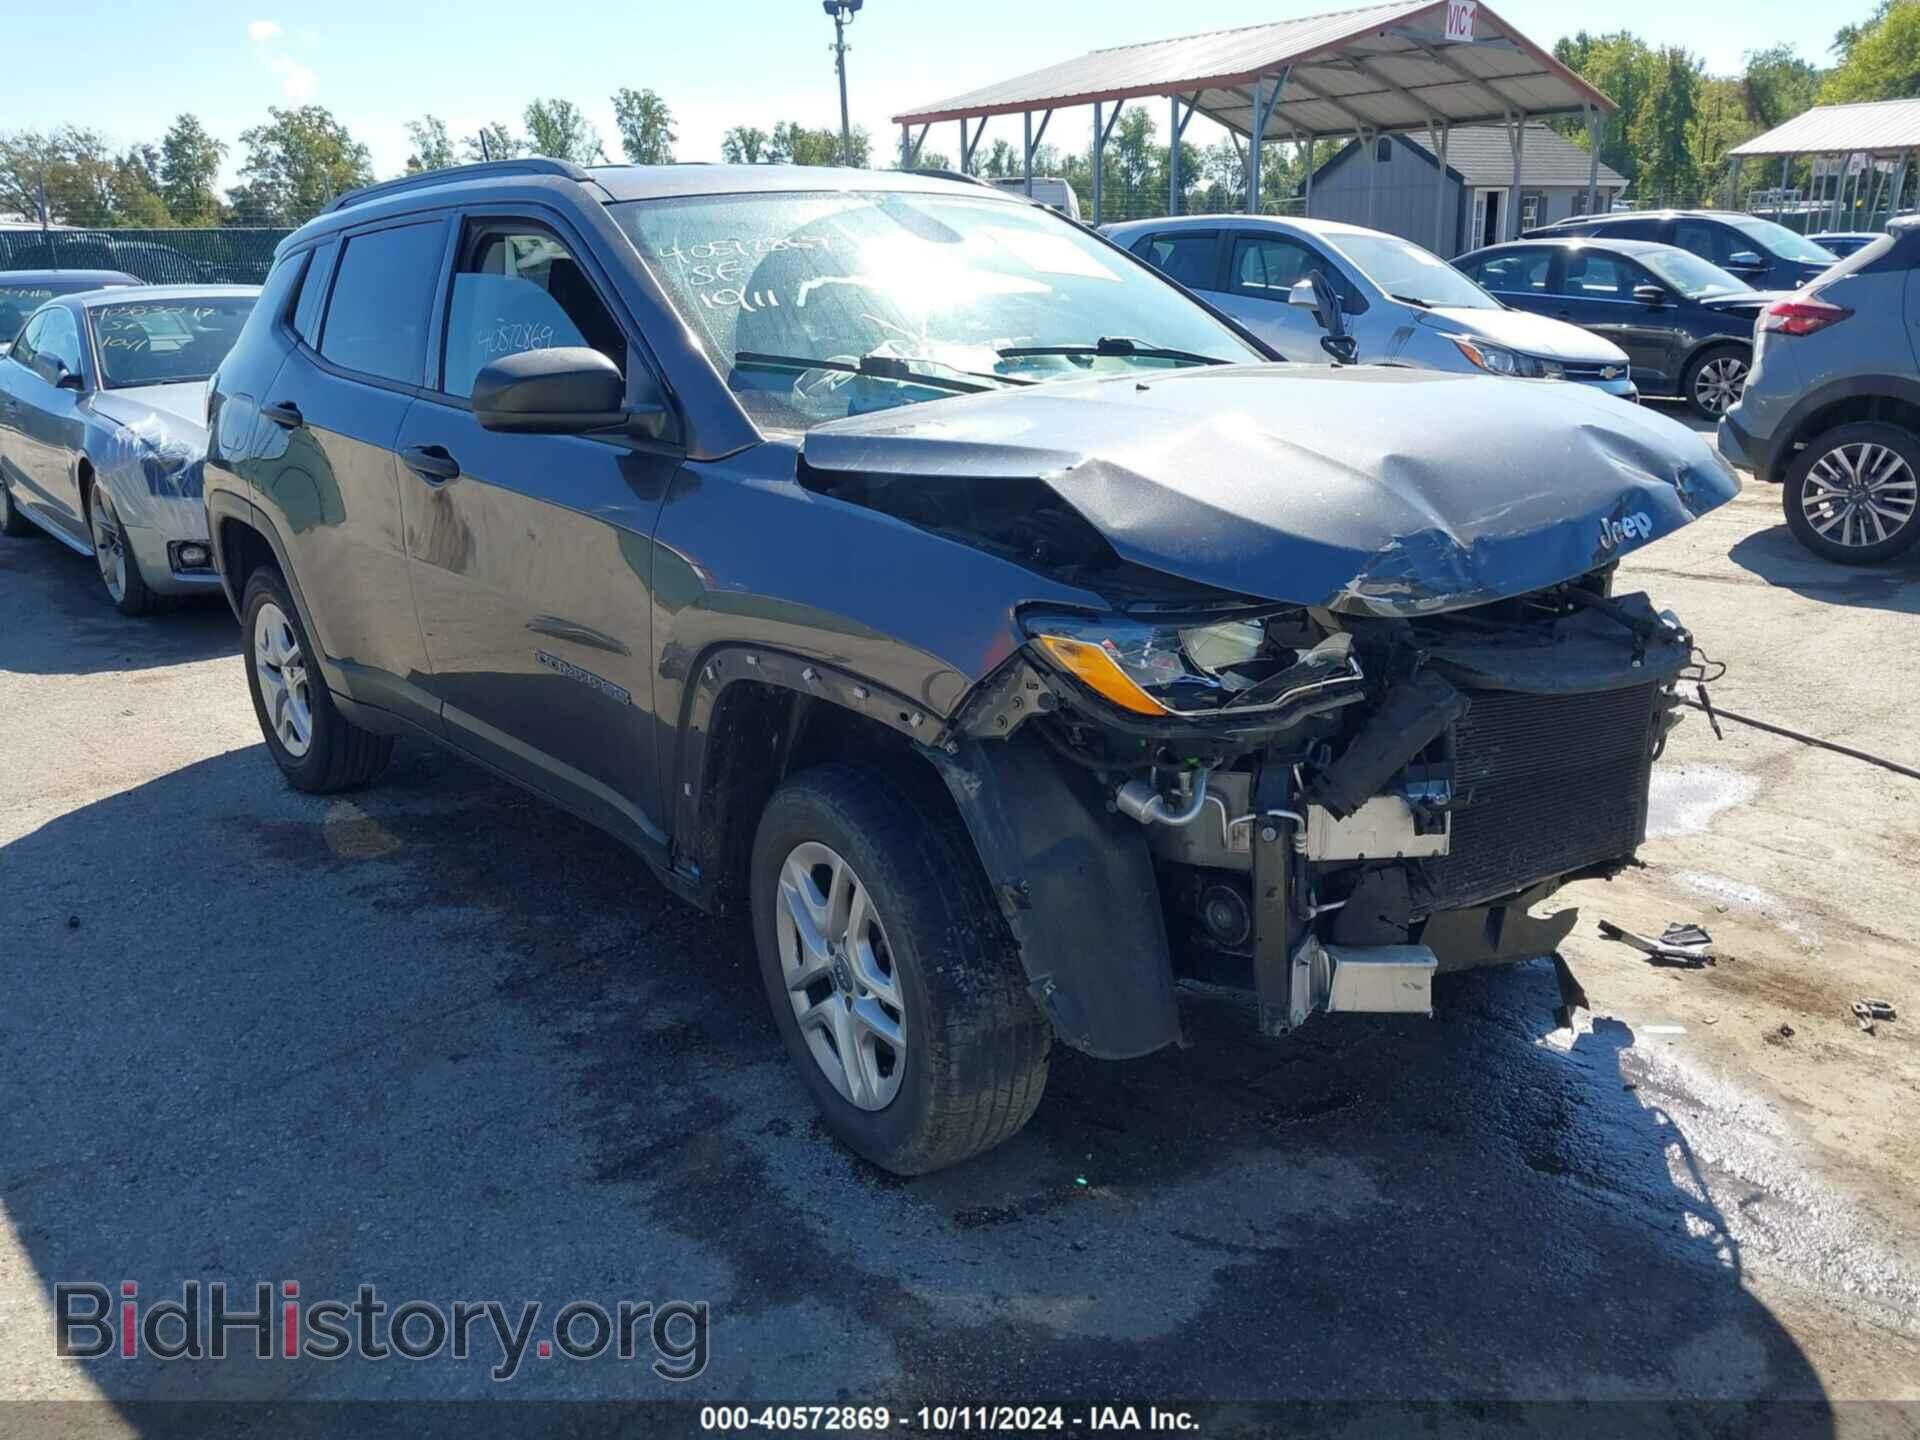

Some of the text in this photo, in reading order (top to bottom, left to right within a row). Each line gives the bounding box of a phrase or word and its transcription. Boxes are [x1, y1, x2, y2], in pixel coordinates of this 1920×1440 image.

[1448, 4, 1468, 35] VIC
[690, 261, 743, 285] SE
[1600, 511, 1652, 549] Jeep
